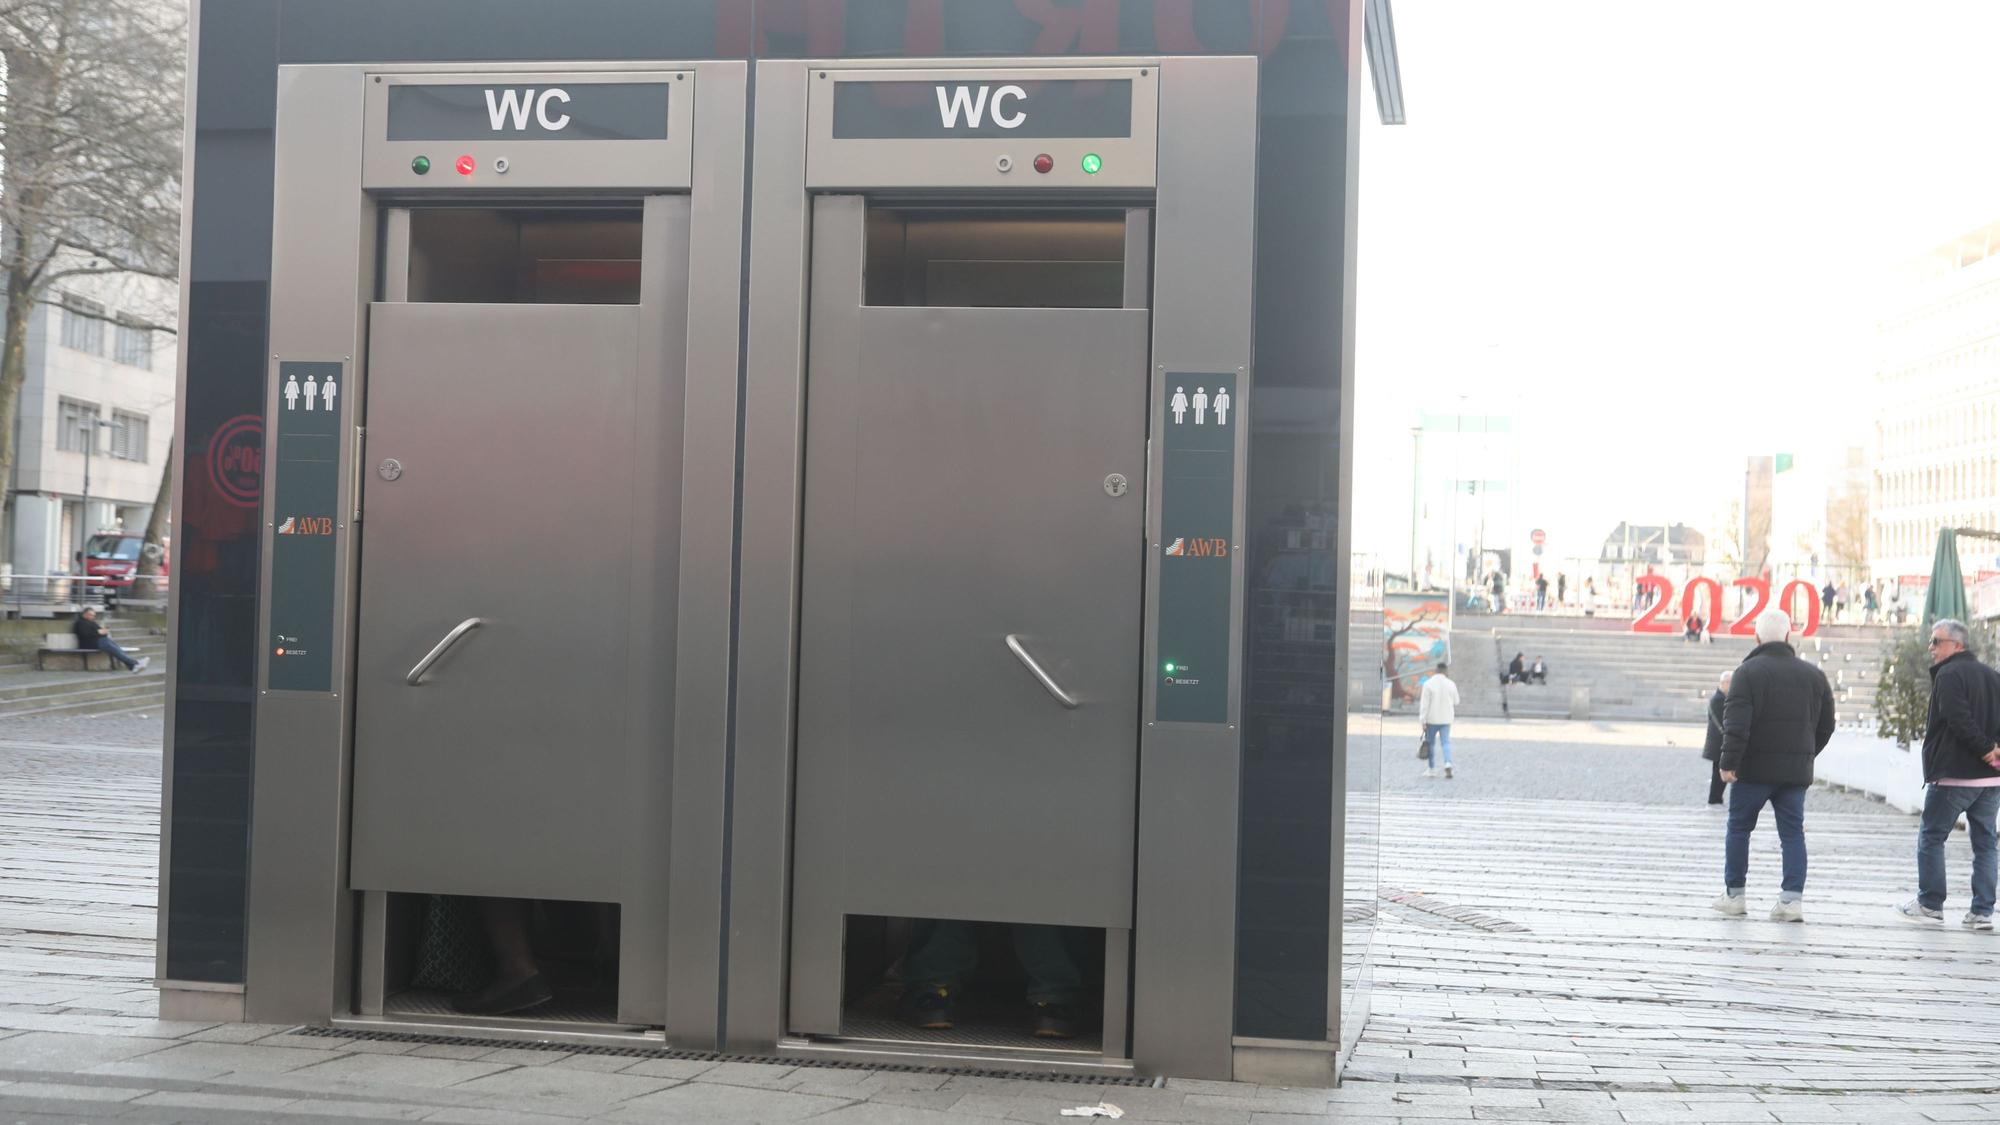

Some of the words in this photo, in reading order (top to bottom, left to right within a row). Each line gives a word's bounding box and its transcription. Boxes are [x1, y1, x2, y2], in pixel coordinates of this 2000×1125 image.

[484, 88, 571, 131] WC
[936, 85, 1027, 129] WC
[297, 517, 332, 535] AWB
[1187, 538, 1227, 557] AWB
[1632, 573, 1820, 637] 2020
